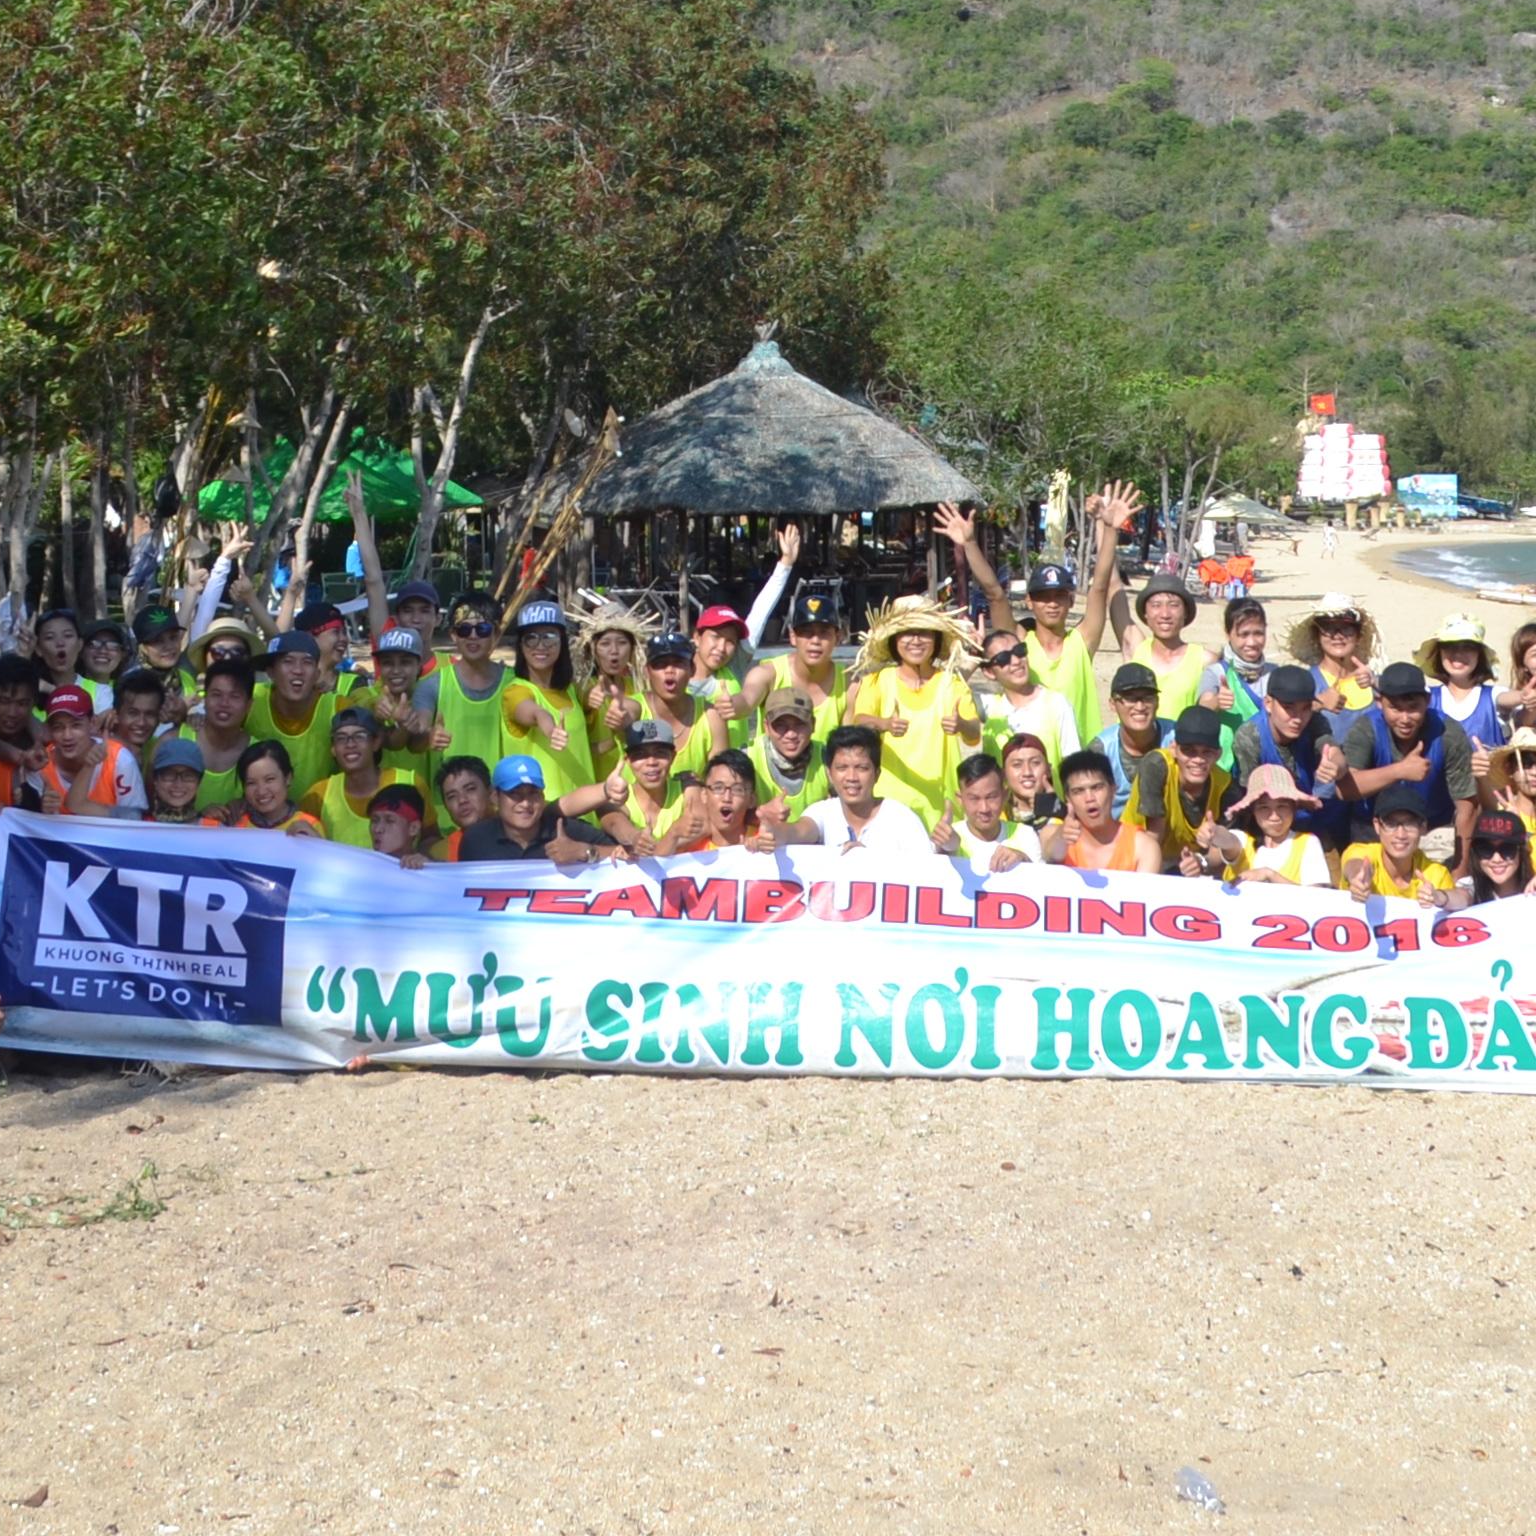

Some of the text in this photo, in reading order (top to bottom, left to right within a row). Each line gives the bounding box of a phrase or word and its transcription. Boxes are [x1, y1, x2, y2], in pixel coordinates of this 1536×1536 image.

[522, 605, 556, 625] WHAT!
[379, 629, 413, 649] WHAT!
[39, 860, 248, 954] KTR
[464, 876, 1492, 952] TEAMBUILDING 2016
[44, 946, 239, 978] KHUONG THINH REAL
[149, 982, 191, 1005] DO
[581, 979, 805, 1066] SINH
[834, 966, 1002, 1070] NƠI
[1030, 986, 1374, 1071] HOANG
